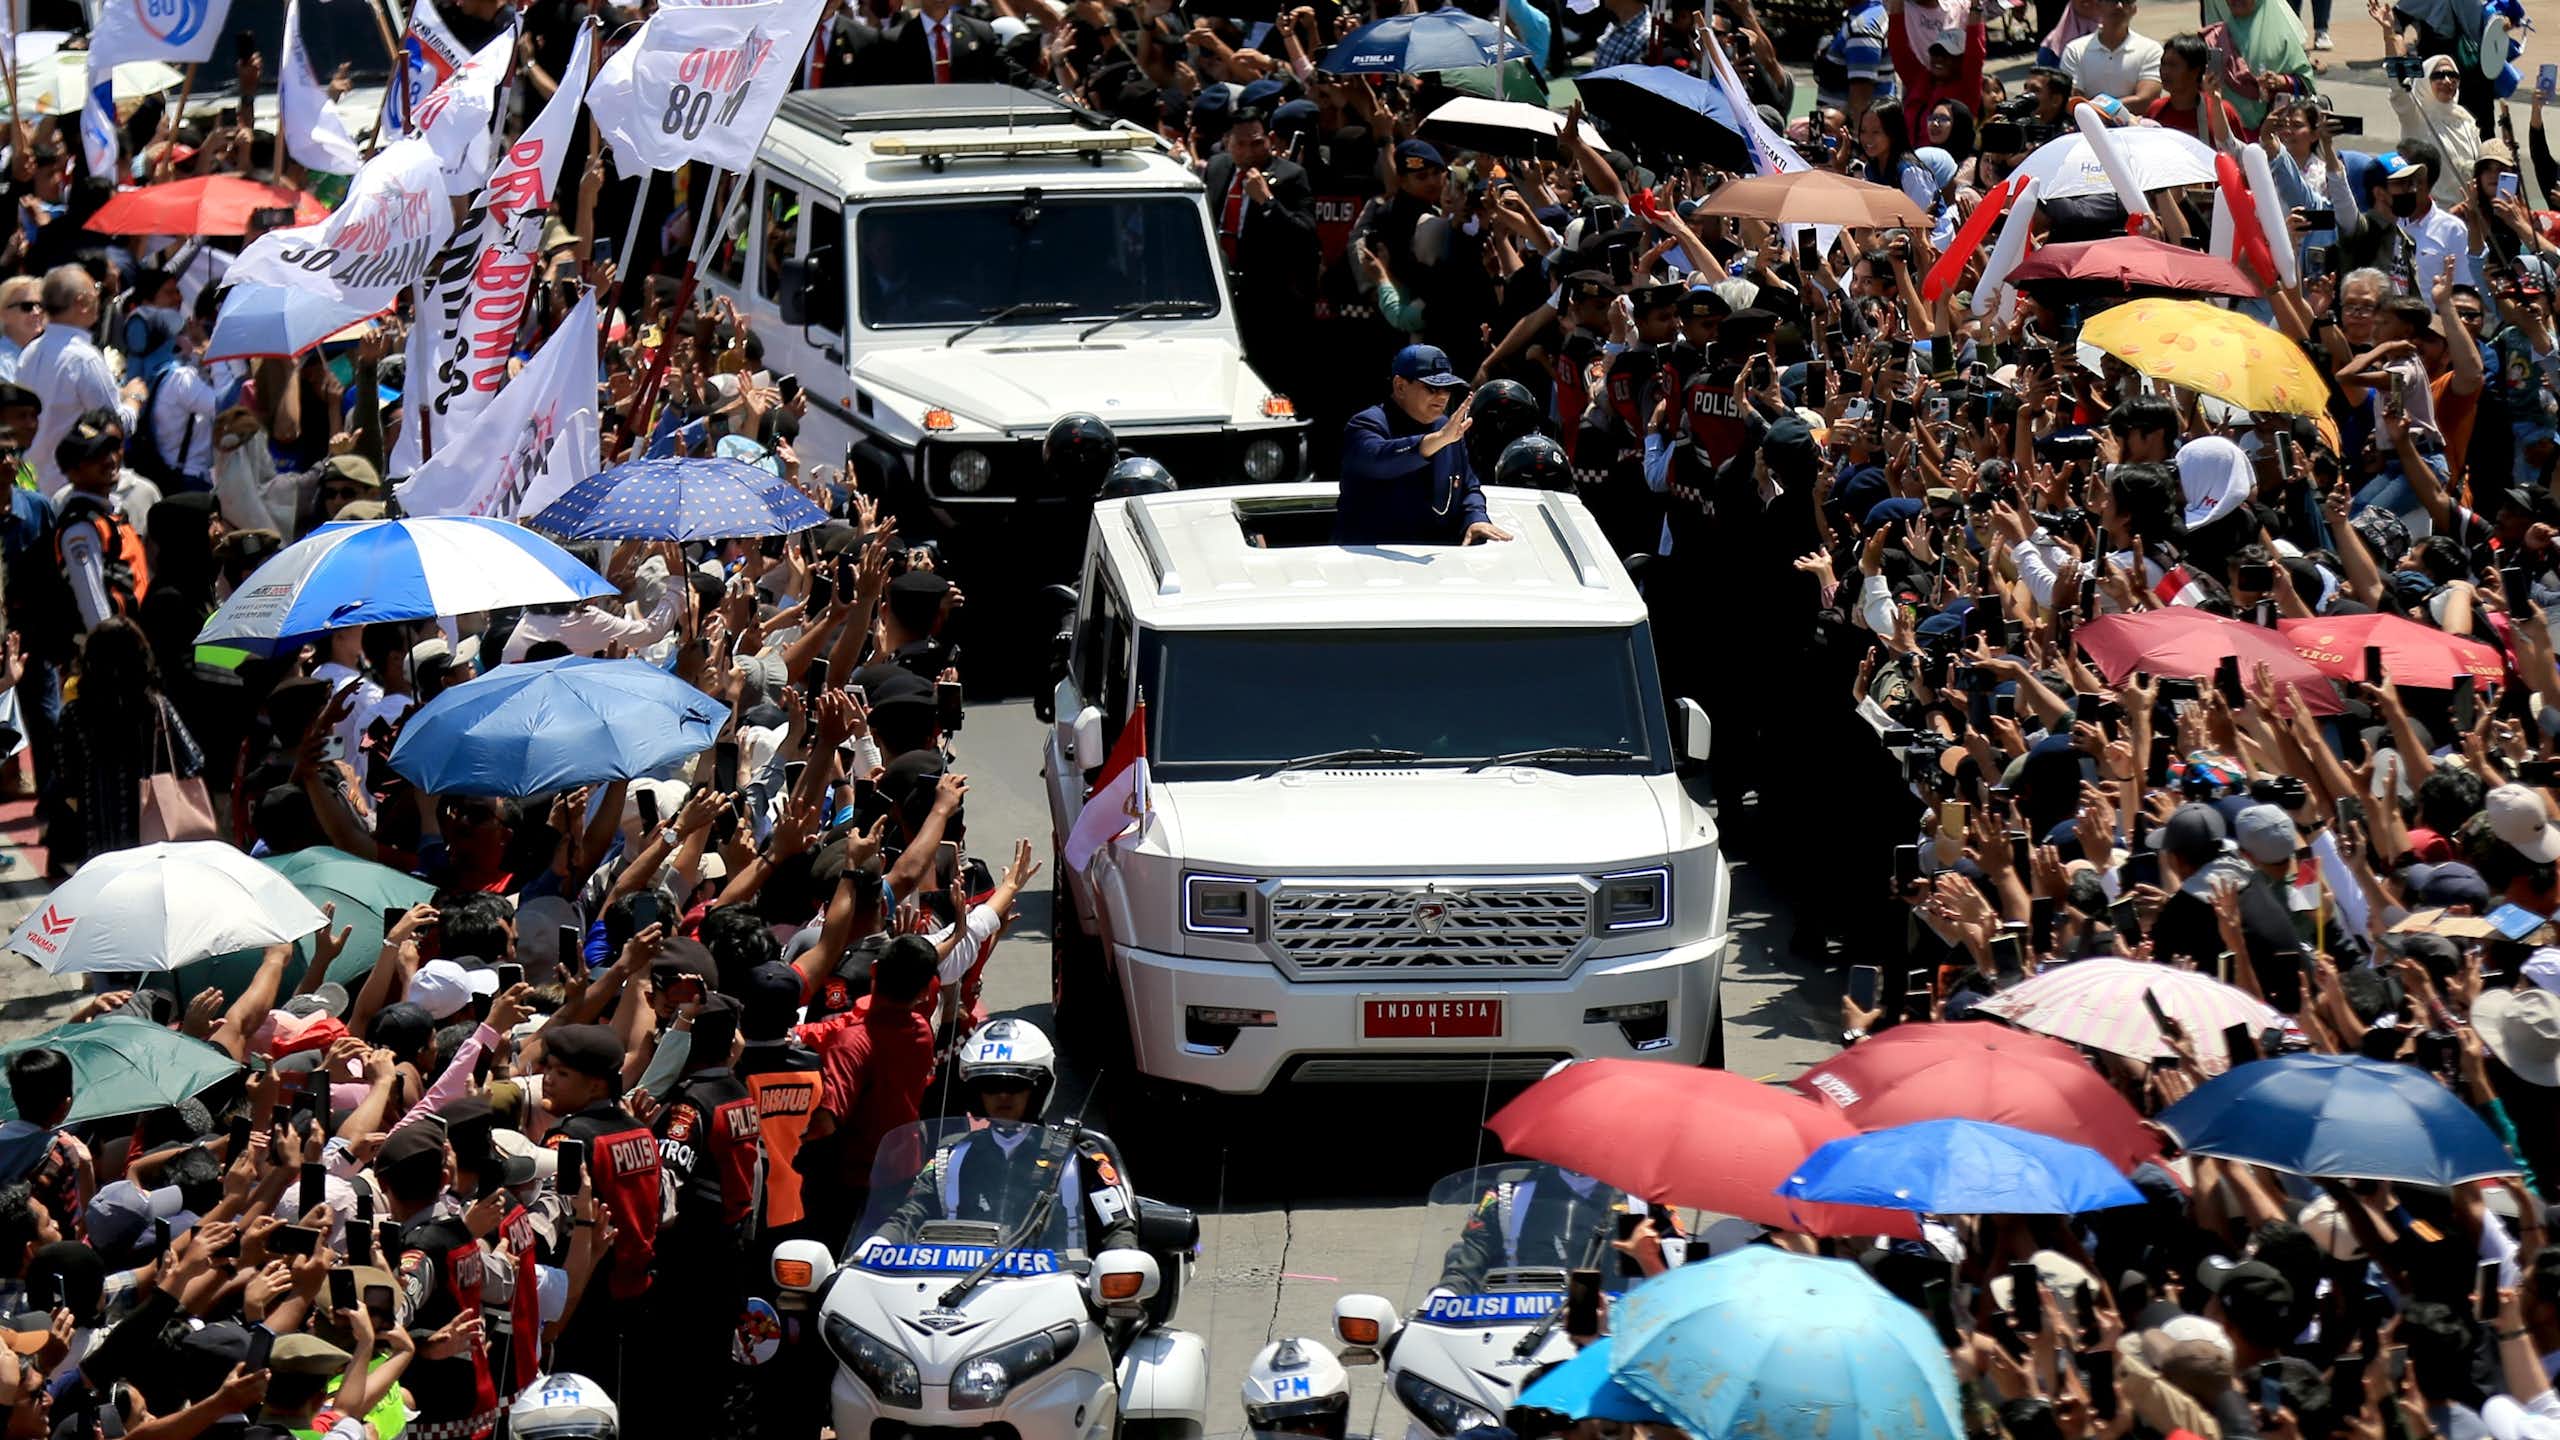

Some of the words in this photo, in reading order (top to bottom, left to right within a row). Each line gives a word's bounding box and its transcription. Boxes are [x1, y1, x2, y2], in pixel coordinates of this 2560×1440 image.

[1377, 1003, 1487, 1018] INDONESIA
[1430, 1021, 1436, 1035] 1
[979, 1043, 1014, 1061] PM
[761, 1087, 812, 1114] DISHUB
[866, 1245, 940, 1266] POLISI
[1431, 1297, 1510, 1318] POLISI
[543, 1389, 581, 1406] PM
[1274, 1376, 1311, 1401] PM
